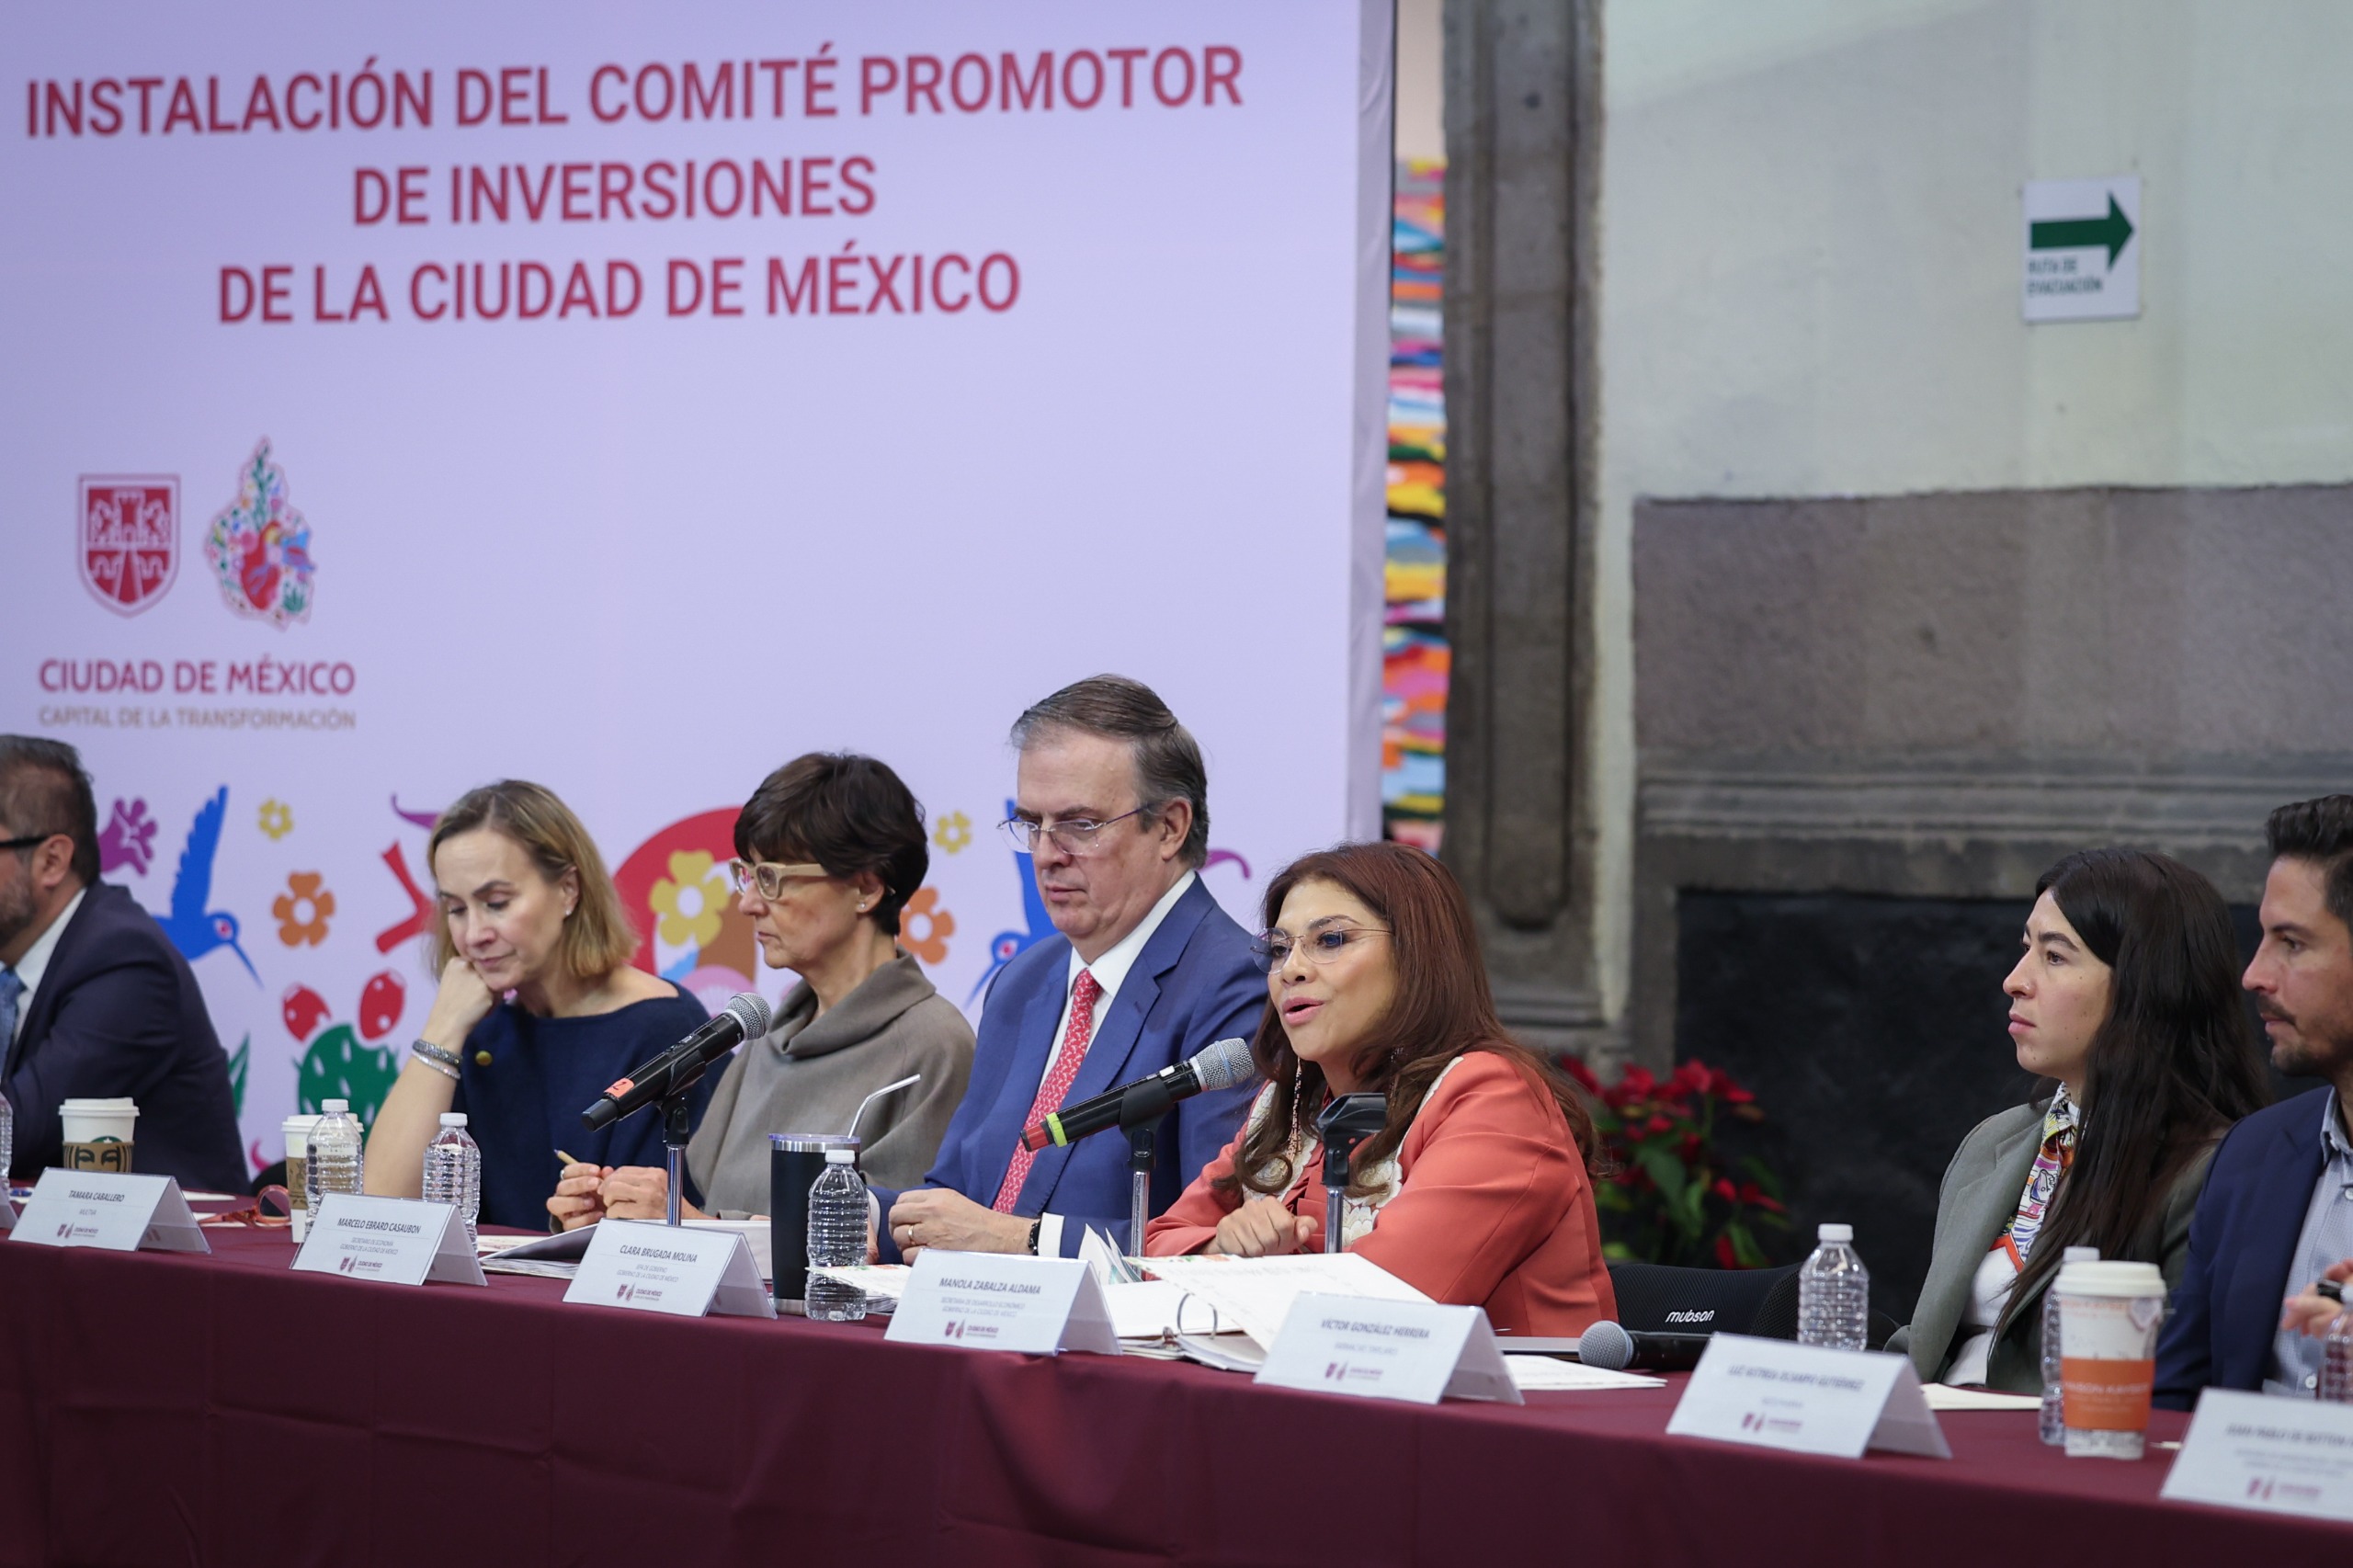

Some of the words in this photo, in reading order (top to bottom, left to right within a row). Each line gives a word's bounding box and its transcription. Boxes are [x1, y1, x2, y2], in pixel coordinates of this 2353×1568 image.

[27, 56, 433, 138] INSTALACIÓN
[456, 66, 569, 127] DEL
[589, 42, 838, 123] COMITÉ
[859, 45, 1244, 116] PROMOTOR
[354, 167, 430, 226] DE
[451, 155, 877, 223] INVERSIONES
[220, 266, 293, 324] DE
[315, 265, 390, 324] LA
[409, 259, 642, 322] CIUDAD
[667, 257, 745, 318] DE
[767, 240, 1022, 317] MÉXICO
[39, 659, 165, 694] CIUDAD
[174, 661, 218, 695] DE
[227, 653, 357, 696] MÉXICO
[39, 706, 112, 729] CAPITAL
[118, 706, 144, 729] DE
[148, 707, 171, 728] LA
[177, 702, 357, 731] TRANSFORMACIÓN
[68, 1189, 93, 1200] TAMARA
[93, 1192, 125, 1202] CABALLERO
[337, 1218, 366, 1229] MARCELO
[365, 1221, 388, 1232] EBRARD
[388, 1222, 422, 1233] CASAUBON
[620, 1244, 641, 1256] CLARA
[641, 1247, 672, 1259] BRUGADA
[671, 1252, 698, 1263] MOLINA
[938, 1278, 972, 1290] MANOLA
[973, 1280, 1007, 1292] ZABALZA
[1007, 1282, 1041, 1294] ALDAMA
[1665, 1309, 1715, 1323] mubson
